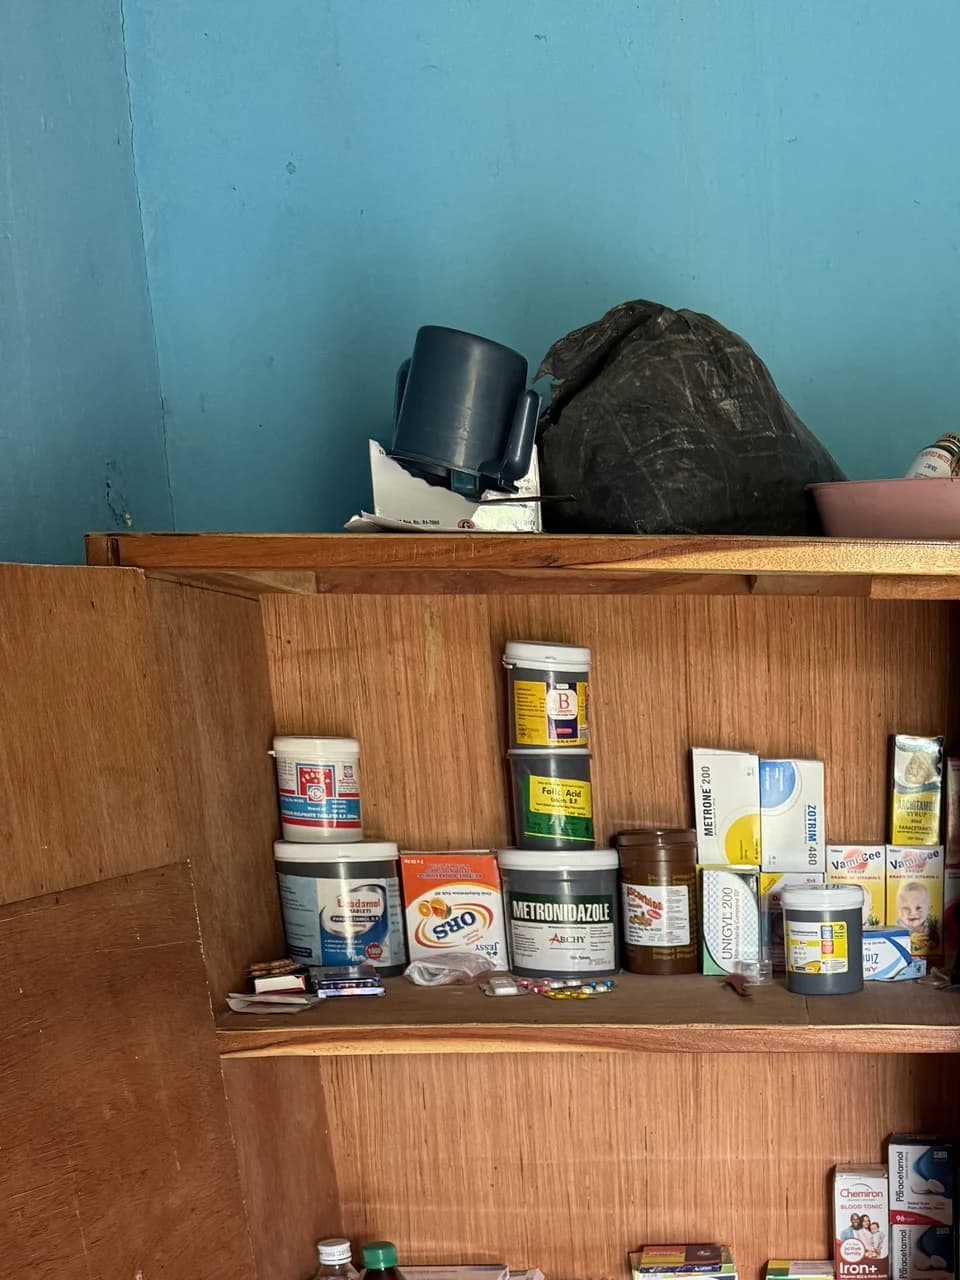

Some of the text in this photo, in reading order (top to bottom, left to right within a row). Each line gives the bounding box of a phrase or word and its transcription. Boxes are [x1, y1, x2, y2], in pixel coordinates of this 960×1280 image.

[559, 693, 570, 709] B
[565, 789, 582, 798] Acid
[701, 766, 713, 837] METRONE 200
[807, 804, 818, 866] ZOTRIM 480
[512, 900, 610, 922] METRONIDAZOLE
[432, 911, 477, 941] ORS
[722, 887, 733, 960] UNIGYL 200
[475, 942, 500, 951] JESSY
[865, 953, 880, 965] Zin
[897, 1151, 905, 1202] Paracetamol
[840, 1188, 883, 1199] Chemiron
[900, 1229, 908, 1279] Paracetamol
[839, 1262, 878, 1274] Iron+
